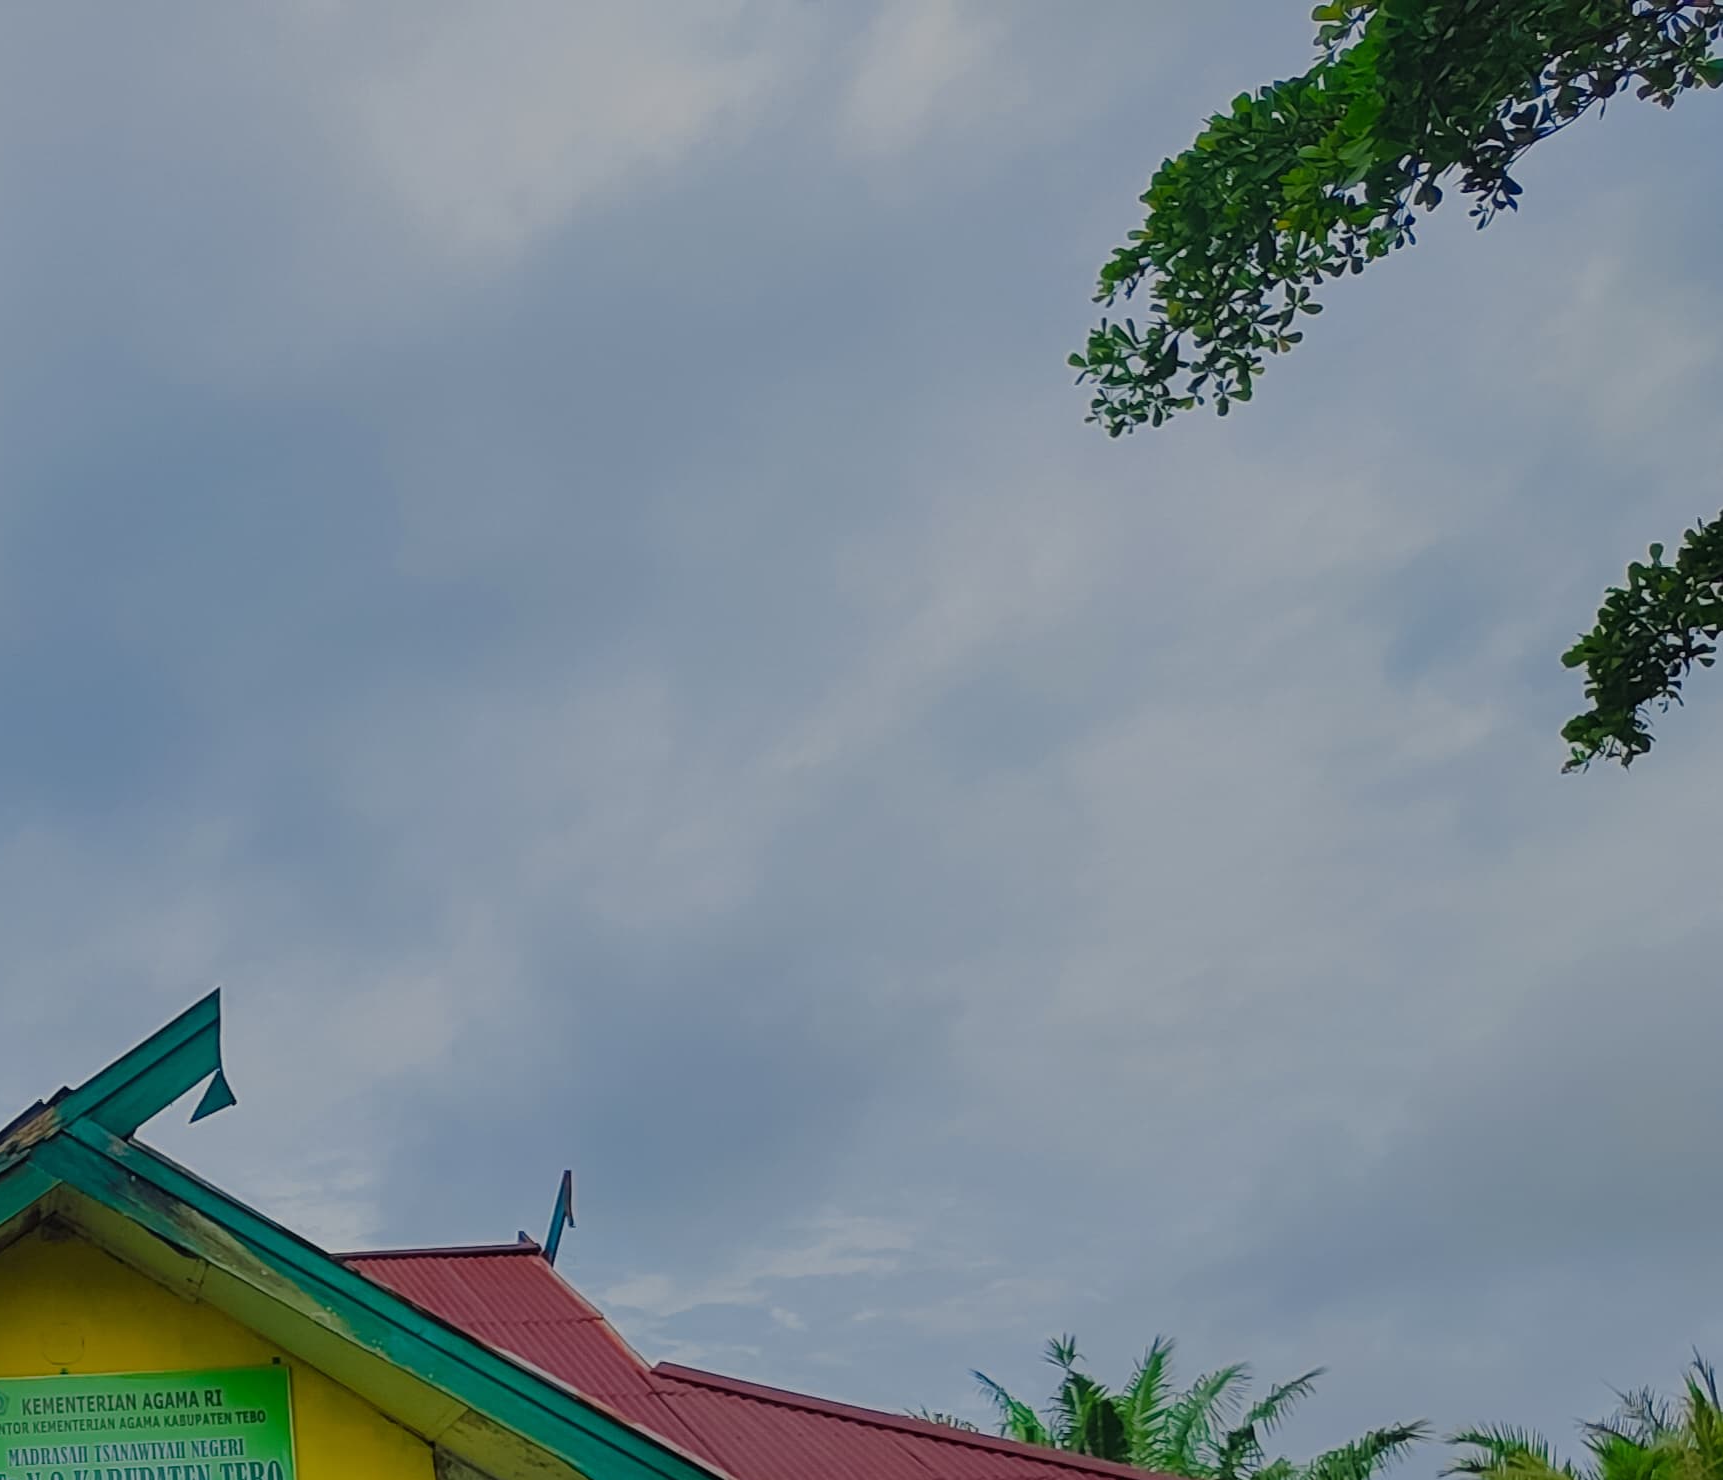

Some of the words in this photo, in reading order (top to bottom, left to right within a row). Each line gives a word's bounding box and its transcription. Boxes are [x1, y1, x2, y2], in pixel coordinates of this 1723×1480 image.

[22, 1393, 137, 1416] KEMENTERIAN
[143, 1391, 200, 1410] AGAMA
[204, 1389, 223, 1407] RI
[33, 1417, 115, 1433] KEMENTERIAN
[119, 1416, 161, 1430] AGAMA
[163, 1412, 232, 1428] KABUPATEN
[236, 1410, 266, 1424] TEBO
[8, 1445, 88, 1467] MADRASAH
[94, 1440, 186, 1463] TSANAWIYAH
[191, 1438, 245, 1458] NEGERI
